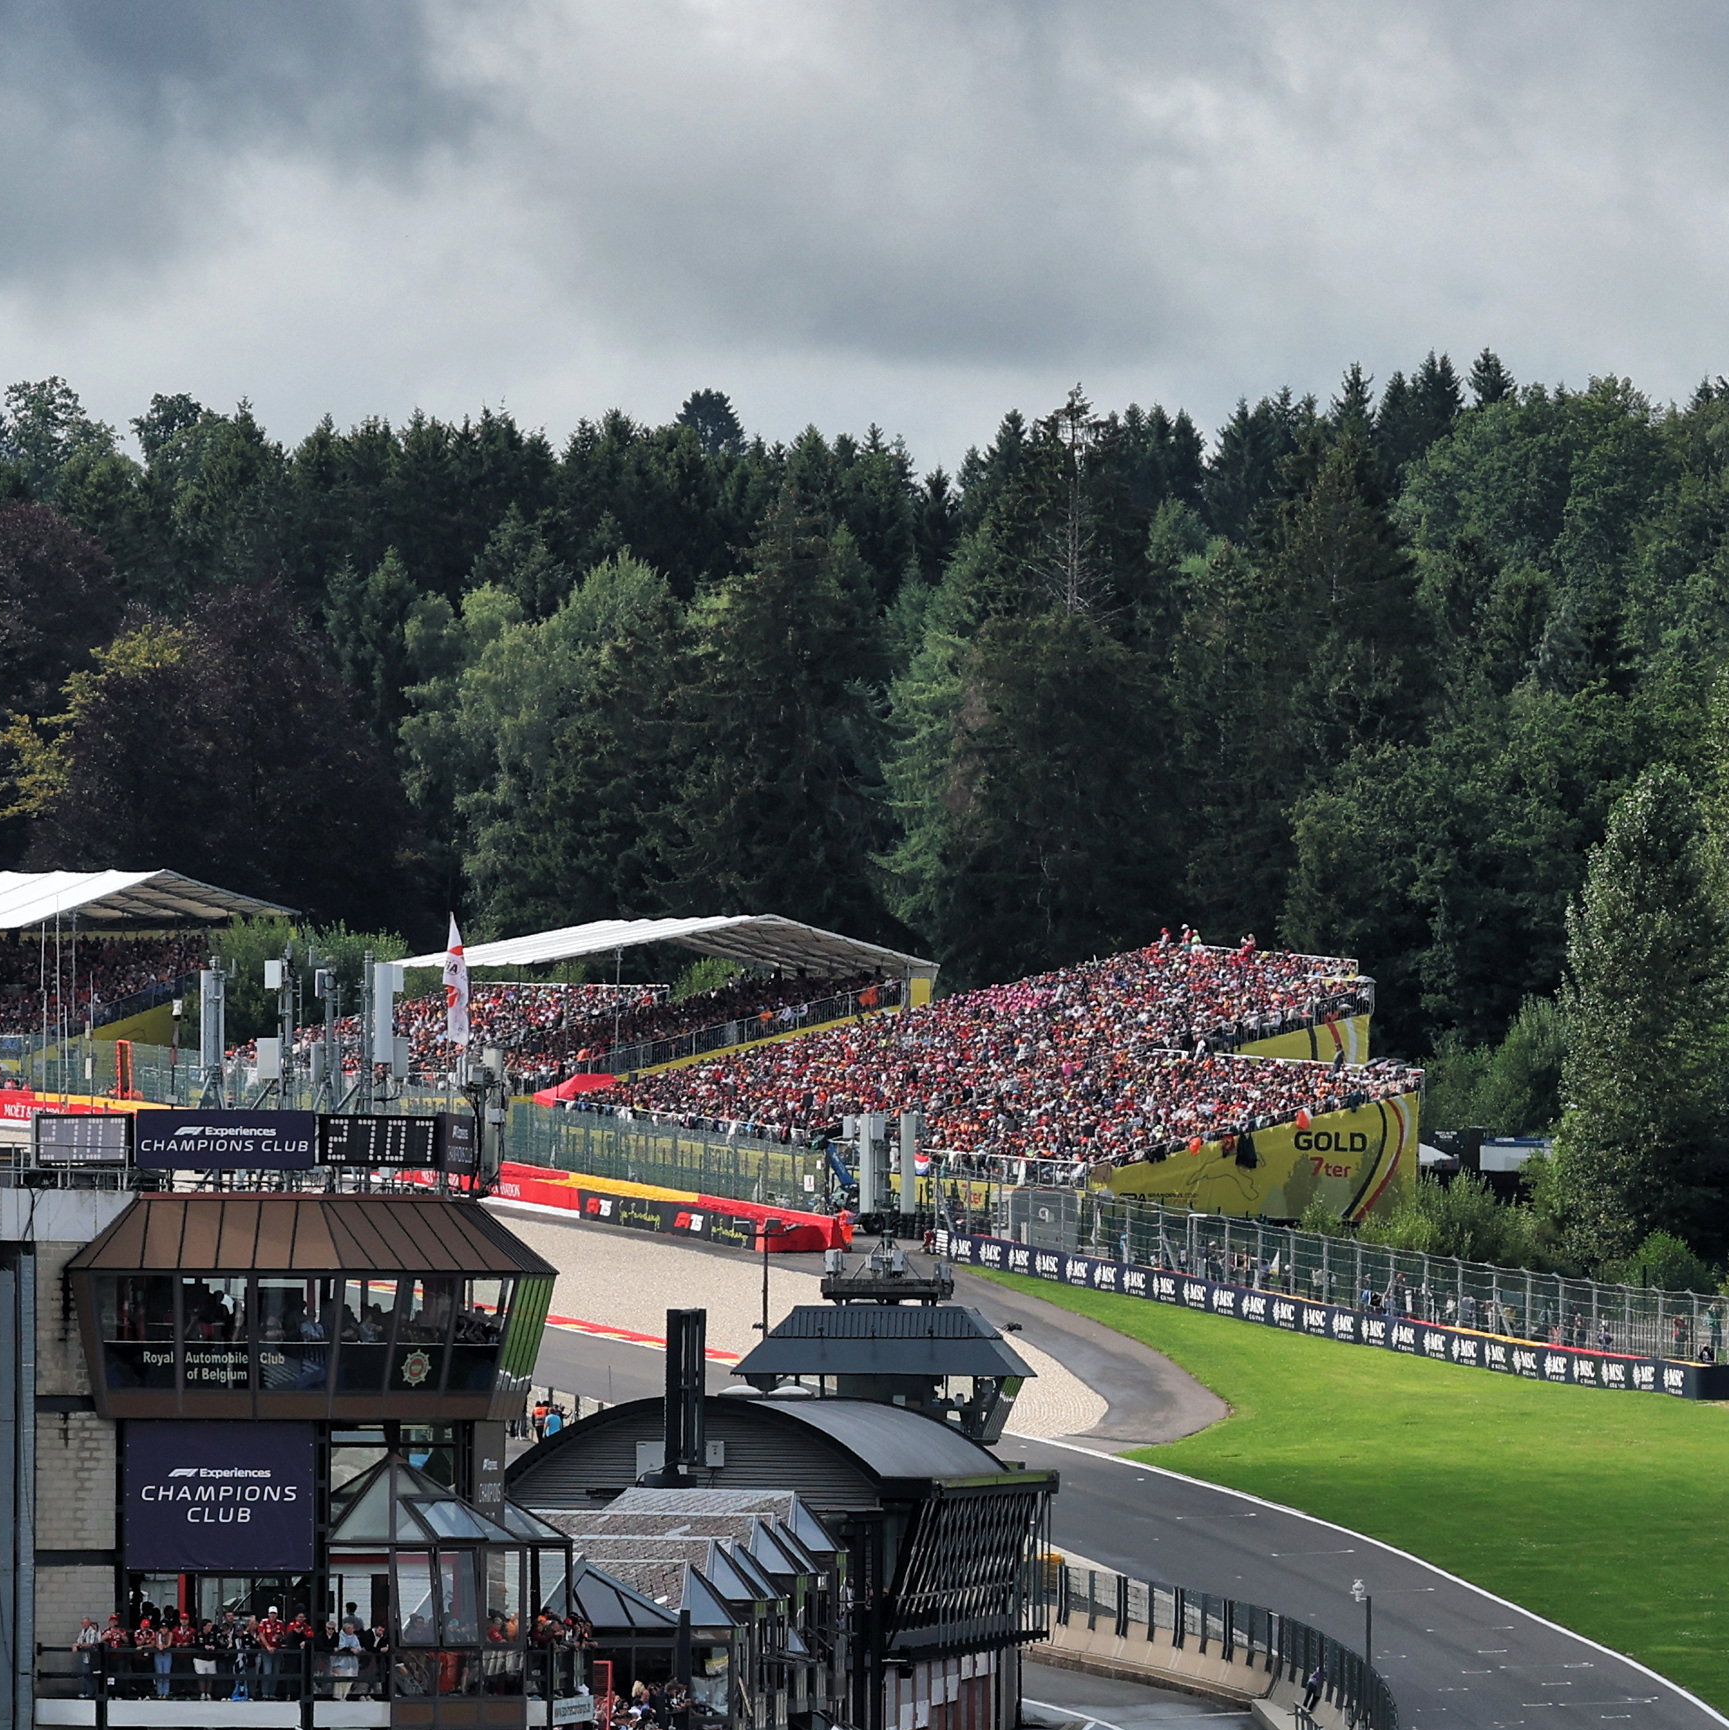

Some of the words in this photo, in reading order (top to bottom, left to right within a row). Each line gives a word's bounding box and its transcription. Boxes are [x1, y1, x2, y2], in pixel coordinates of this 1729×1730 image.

[205, 1126, 277, 1138] Experiences
[140, 1139, 254, 1152] CHAMPIONS
[261, 1140, 310, 1152] CLUB
[327, 1118, 435, 1162] 27.07
[1293, 1131, 1367, 1153] GOLD
[1309, 1156, 1351, 1179] 7ter
[143, 1351, 174, 1365] Royal
[185, 1351, 249, 1365] Automobile
[260, 1352, 285, 1365] Club
[186, 1368, 199, 1380] of
[201, 1368, 247, 1381] Belgium
[199, 1467, 271, 1479] Experiences
[141, 1485, 297, 1501] CHAMPIONS
[187, 1507, 251, 1523] CLUB
